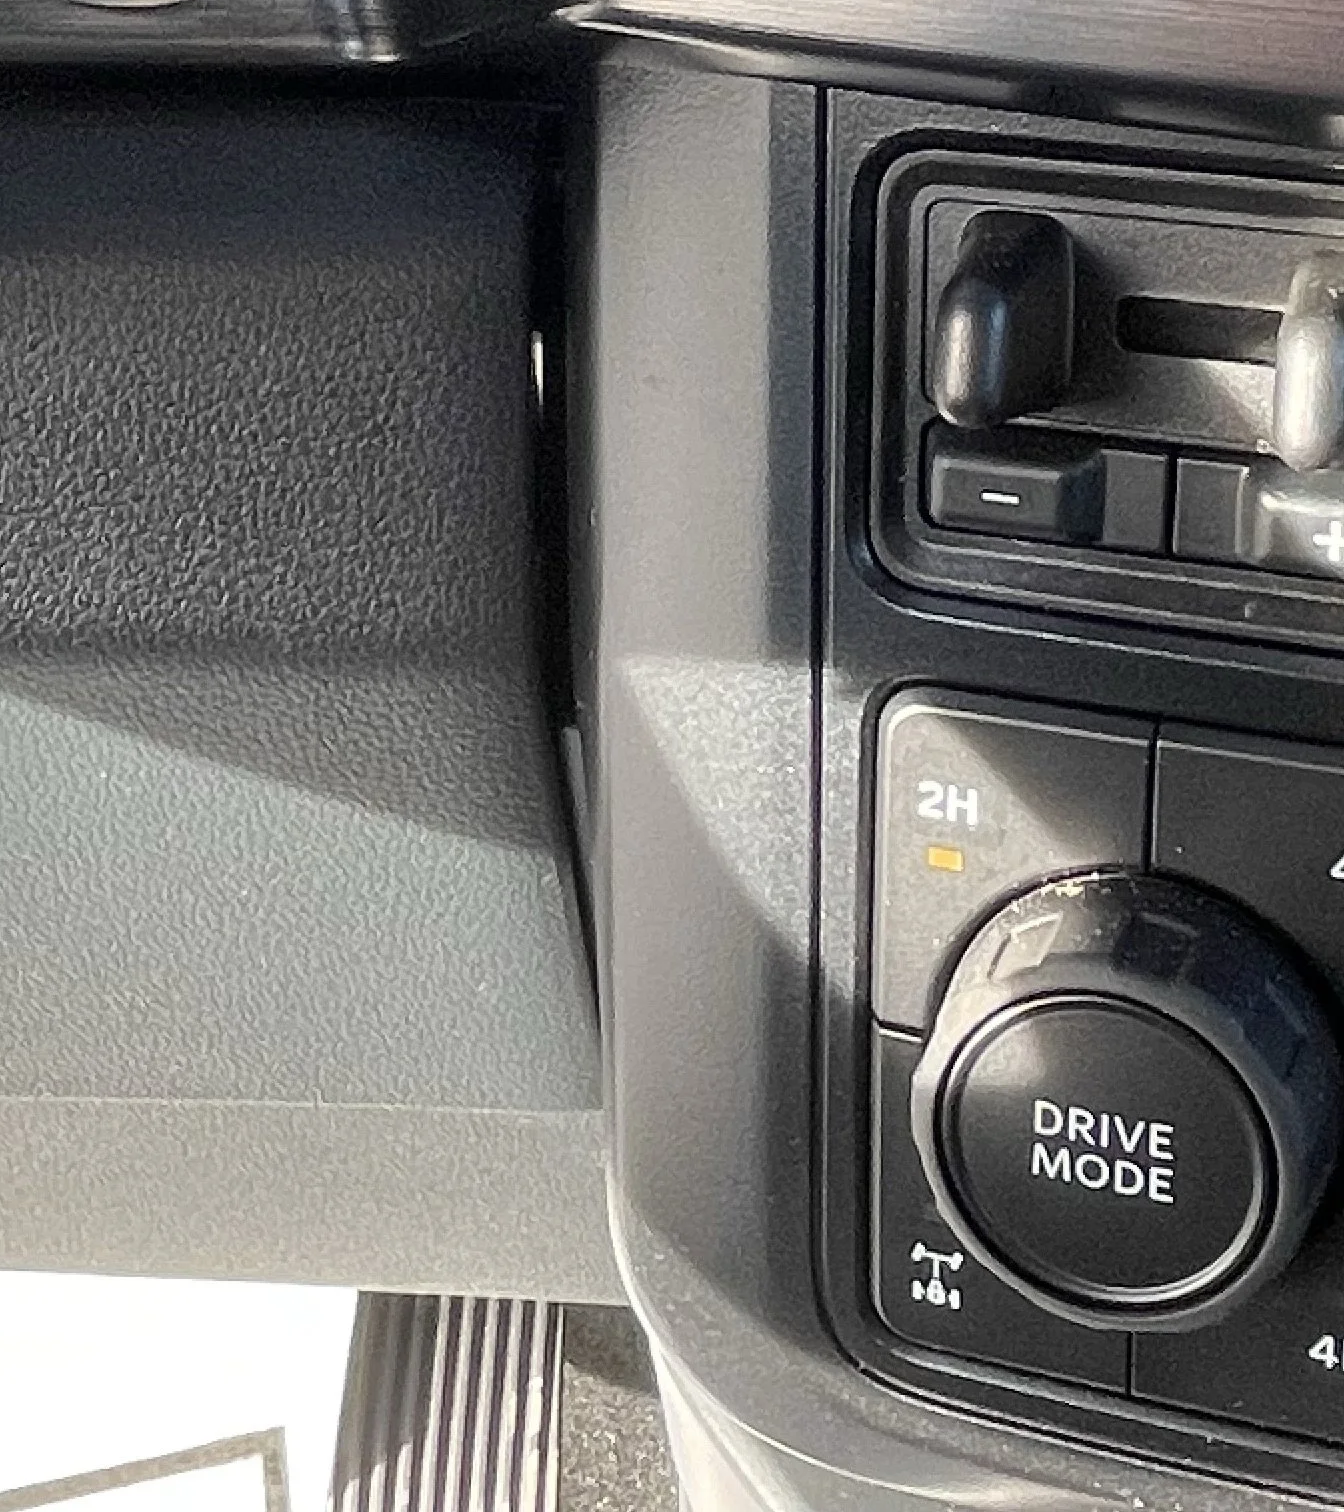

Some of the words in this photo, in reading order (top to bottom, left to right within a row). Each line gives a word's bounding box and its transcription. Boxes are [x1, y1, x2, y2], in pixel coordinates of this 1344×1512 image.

[917, 782, 978, 827] 2H
[1033, 1100, 1175, 1161] DRIVE
[1031, 1143, 1175, 1204] MODE
